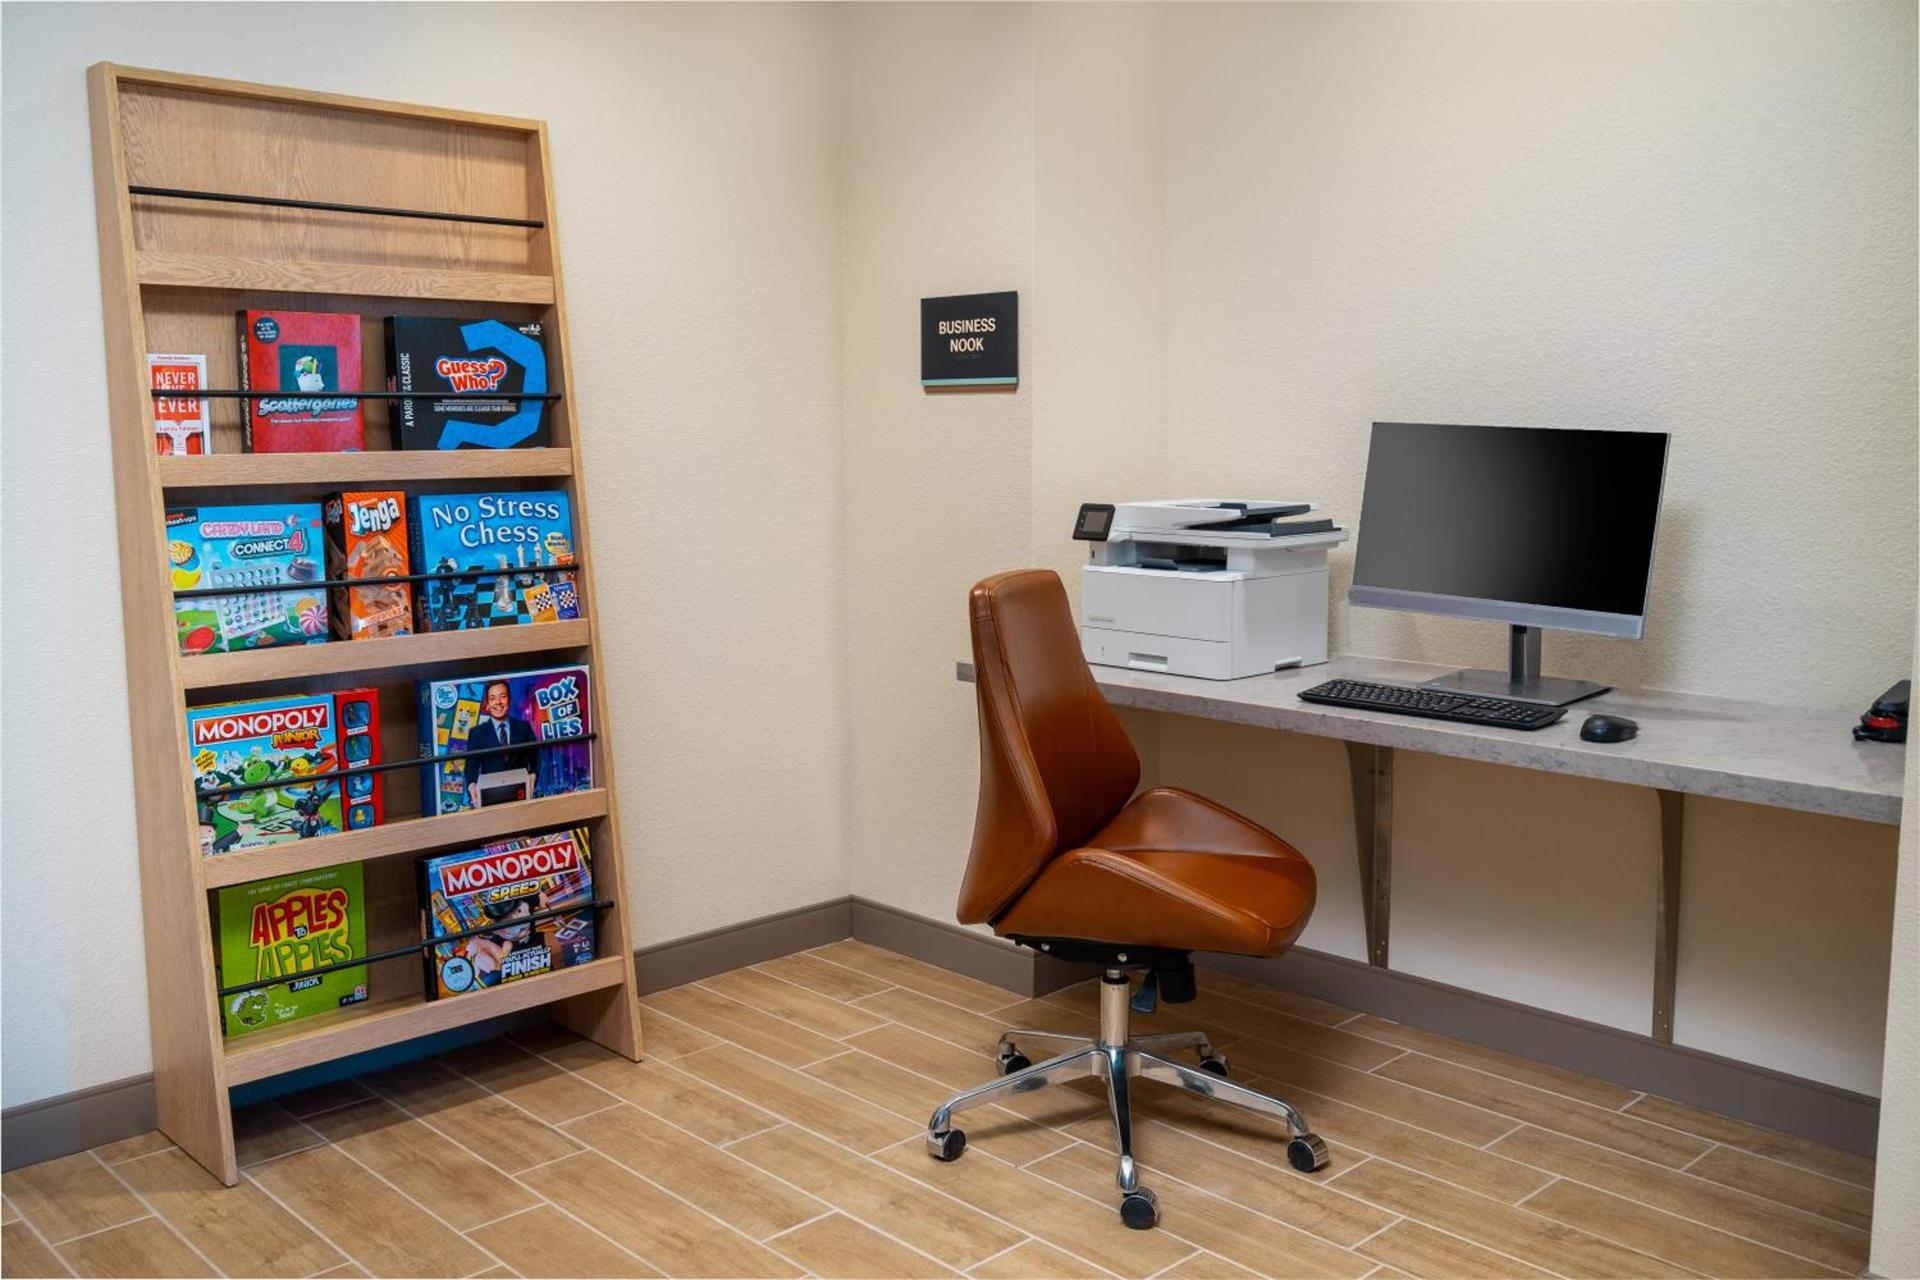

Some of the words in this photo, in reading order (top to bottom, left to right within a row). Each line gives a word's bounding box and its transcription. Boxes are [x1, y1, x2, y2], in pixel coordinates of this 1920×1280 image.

[938, 318, 996, 335] BUSINESS
[950, 337, 984, 352] NOOK
[155, 371, 196, 385] NEVER
[400, 353, 412, 384] CLASSIC
[437, 359, 487, 377] Guess
[451, 358, 507, 392] Who?
[158, 398, 199, 413] EVER
[405, 418, 415, 427] A
[348, 497, 400, 533] Jenga
[432, 504, 469, 528] No
[478, 496, 560, 519] Stress
[235, 539, 289, 555] CONNECT
[288, 530, 303, 552] 4
[460, 520, 539, 547] Chess
[535, 676, 579, 709] BOX
[557, 703, 573, 717] OF
[199, 706, 325, 741] MONOPOLY
[541, 717, 583, 740] LIES
[272, 727, 320, 749] JUNIOR
[447, 844, 572, 892] MONOPOLY
[490, 879, 540, 903] SPEED
[252, 889, 347, 947] APPLES
[294, 926, 308, 938] TO
[255, 930, 351, 981] APPLES
[501, 951, 552, 979] FINISH
